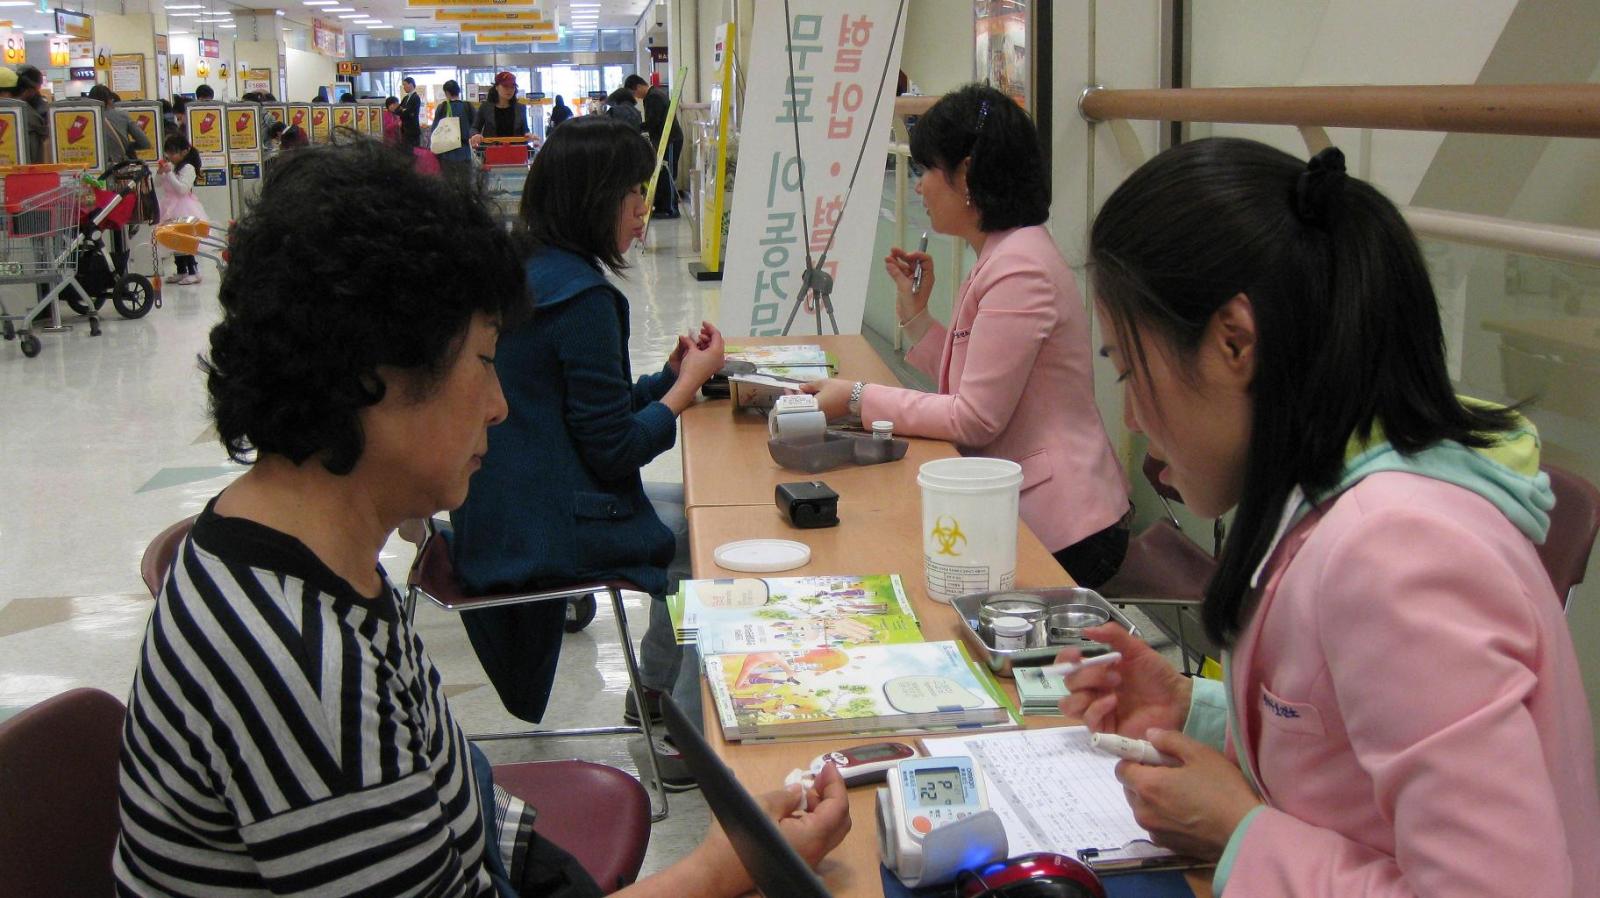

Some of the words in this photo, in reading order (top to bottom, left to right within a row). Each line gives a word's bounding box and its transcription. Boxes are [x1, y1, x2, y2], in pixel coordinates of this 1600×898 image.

[97, 48, 106, 66] 6
[173, 58, 180, 73] 4
[220, 63, 227, 77] 2
[242, 64, 247, 76] 1
